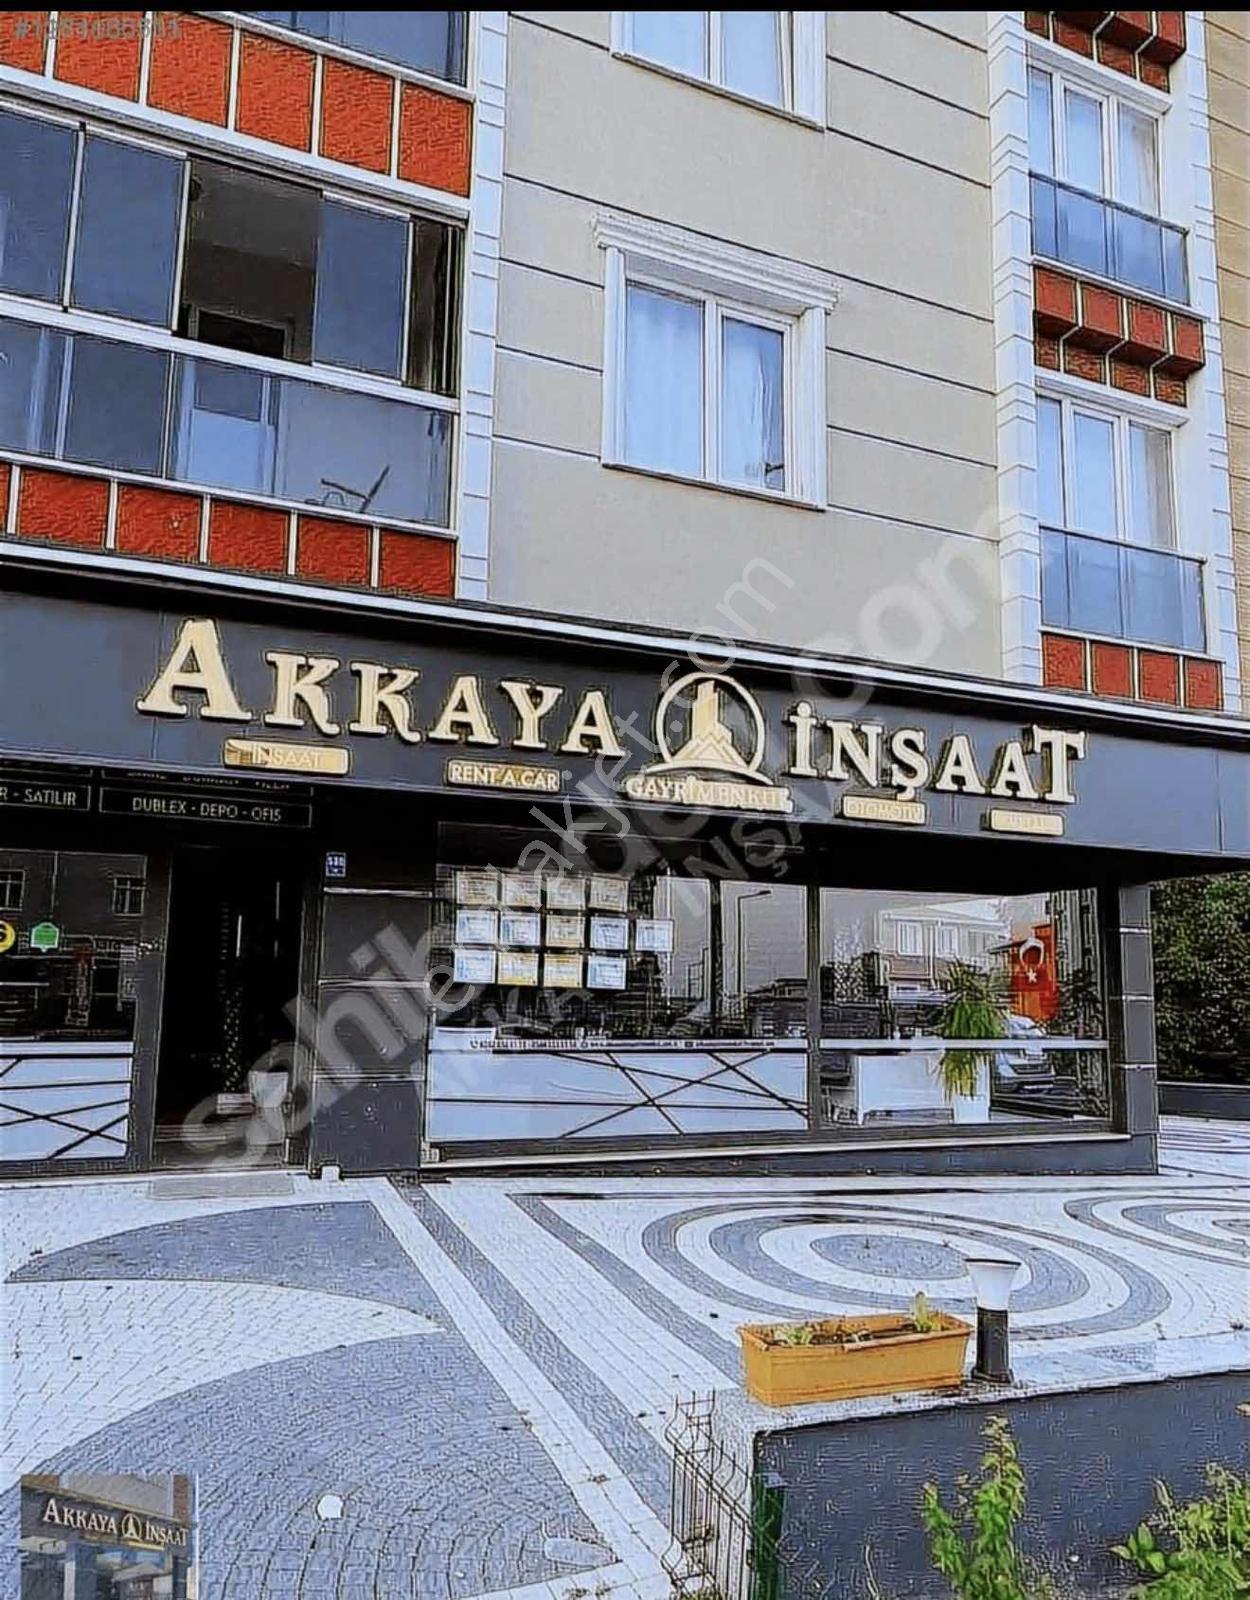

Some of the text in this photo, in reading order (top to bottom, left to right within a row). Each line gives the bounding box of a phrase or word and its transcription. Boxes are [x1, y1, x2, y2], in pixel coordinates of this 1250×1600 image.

[136, 617, 1087, 804] AKKAYA İNŞAAT
[450, 763, 499, 785] RENT
[520, 771, 558, 790] CAR
[24, 788, 77, 807] SATILIR
[132, 797, 188, 815] DUBLEX
[200, 802, 239, 819] DEPO
